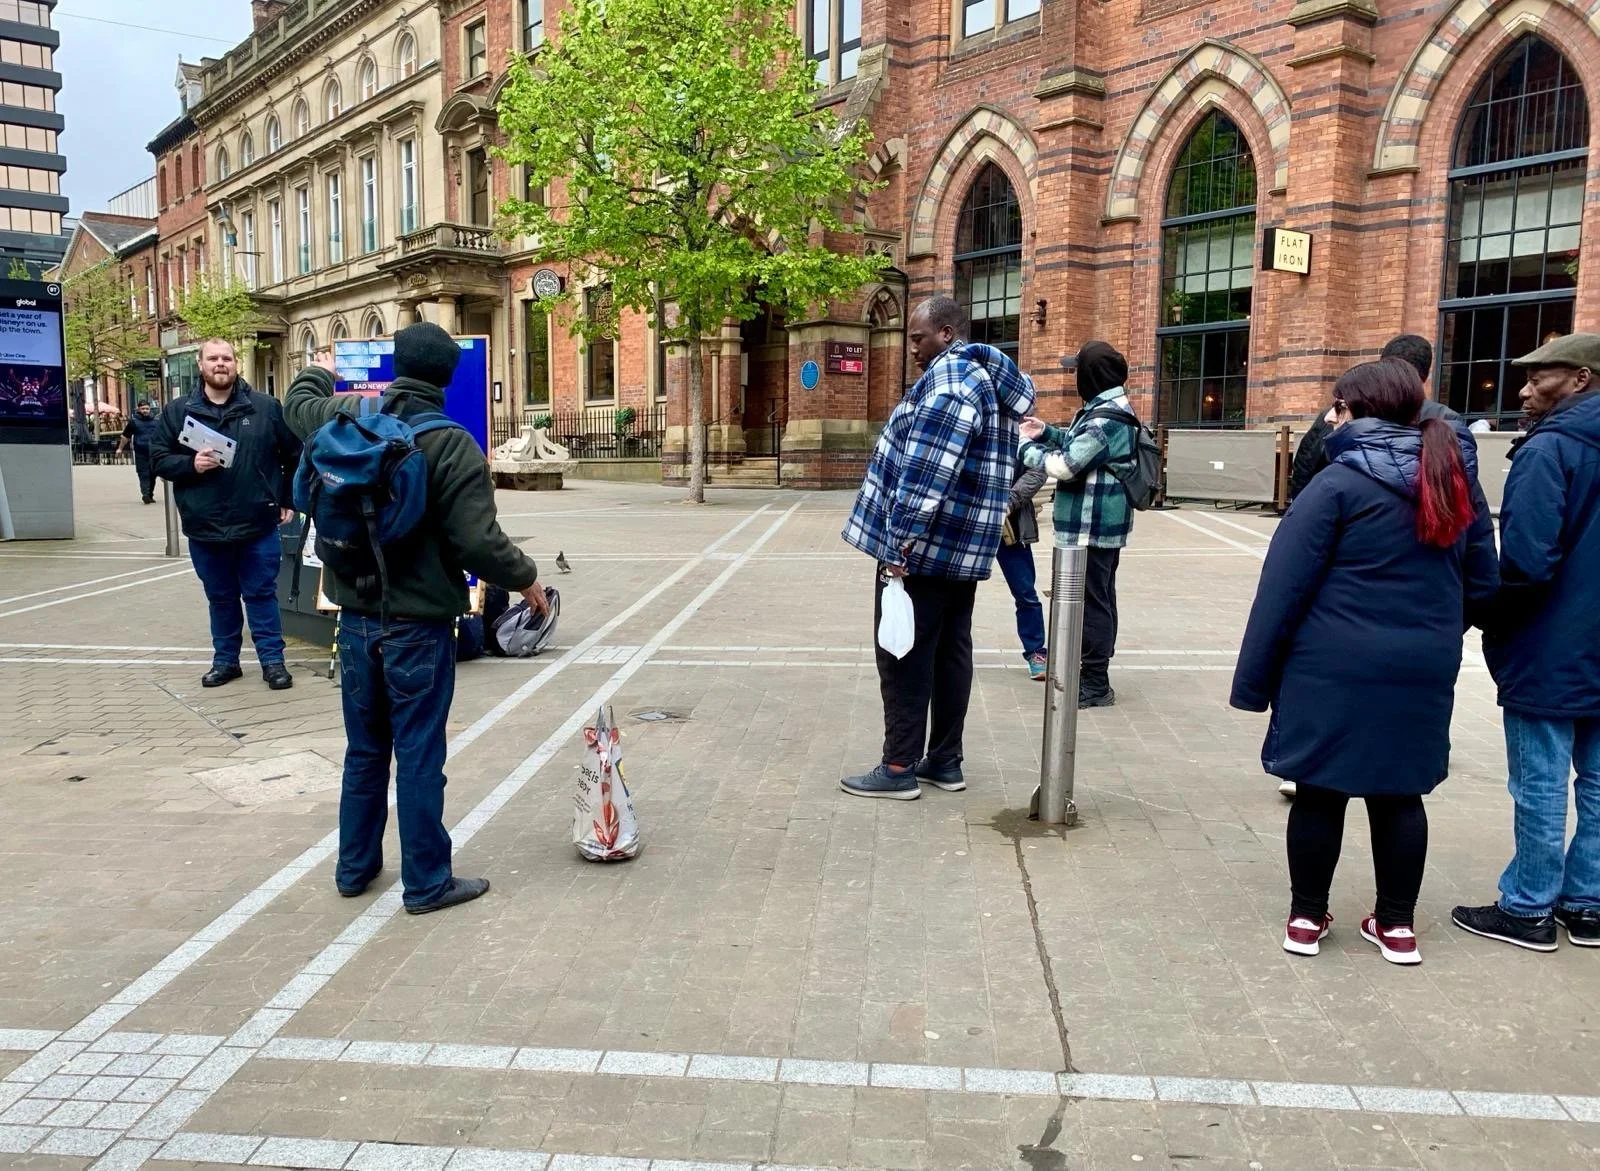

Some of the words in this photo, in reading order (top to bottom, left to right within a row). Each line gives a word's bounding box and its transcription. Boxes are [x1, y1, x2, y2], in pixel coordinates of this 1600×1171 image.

[1280, 236, 1303, 249] FLAT
[1279, 253, 1303, 266] IRON
[16, 298, 37, 307] global
[0, 319, 24, 328] isney+
